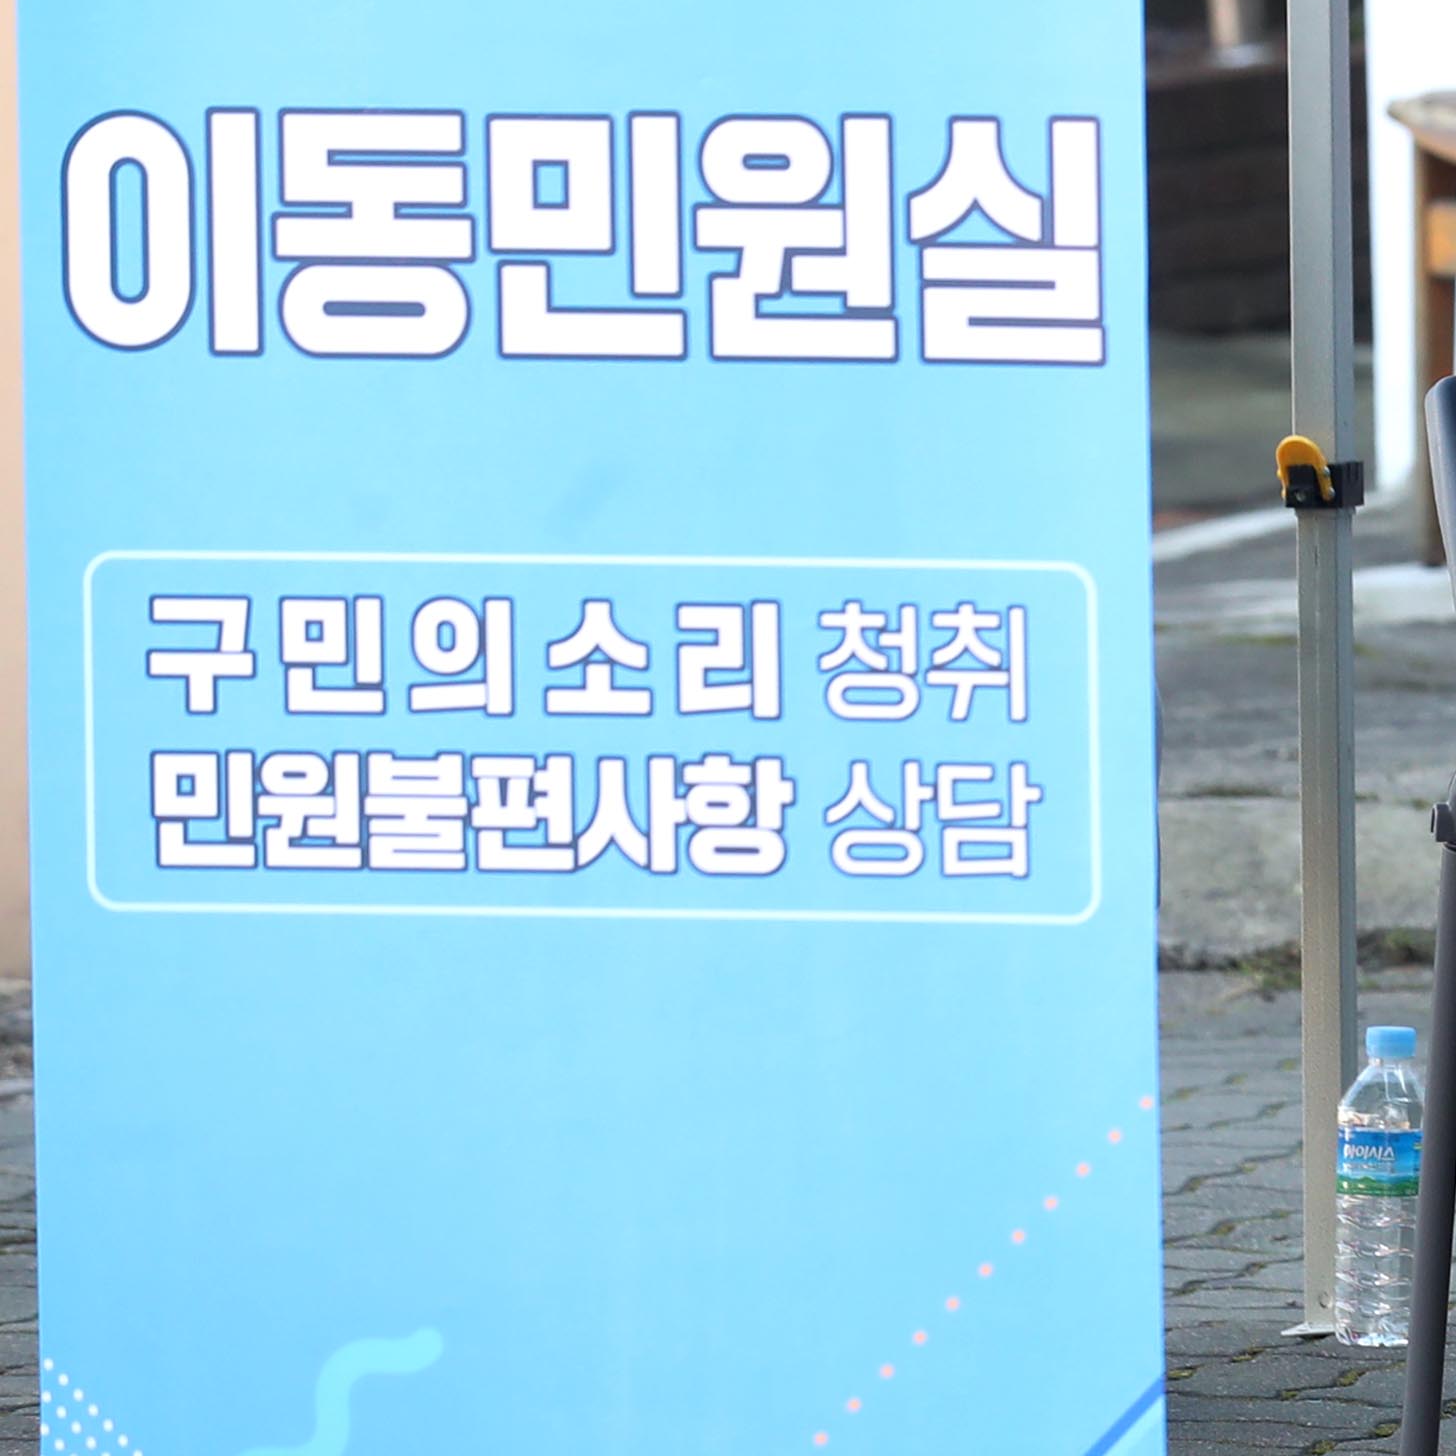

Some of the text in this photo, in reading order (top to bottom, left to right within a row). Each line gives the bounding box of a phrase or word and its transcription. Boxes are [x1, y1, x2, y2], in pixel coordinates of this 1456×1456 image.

[60, 106, 1106, 366] 이동민원실
[816, 601, 1030, 722] 청취
[150, 749, 1042, 878] 민원불편사항 상담
